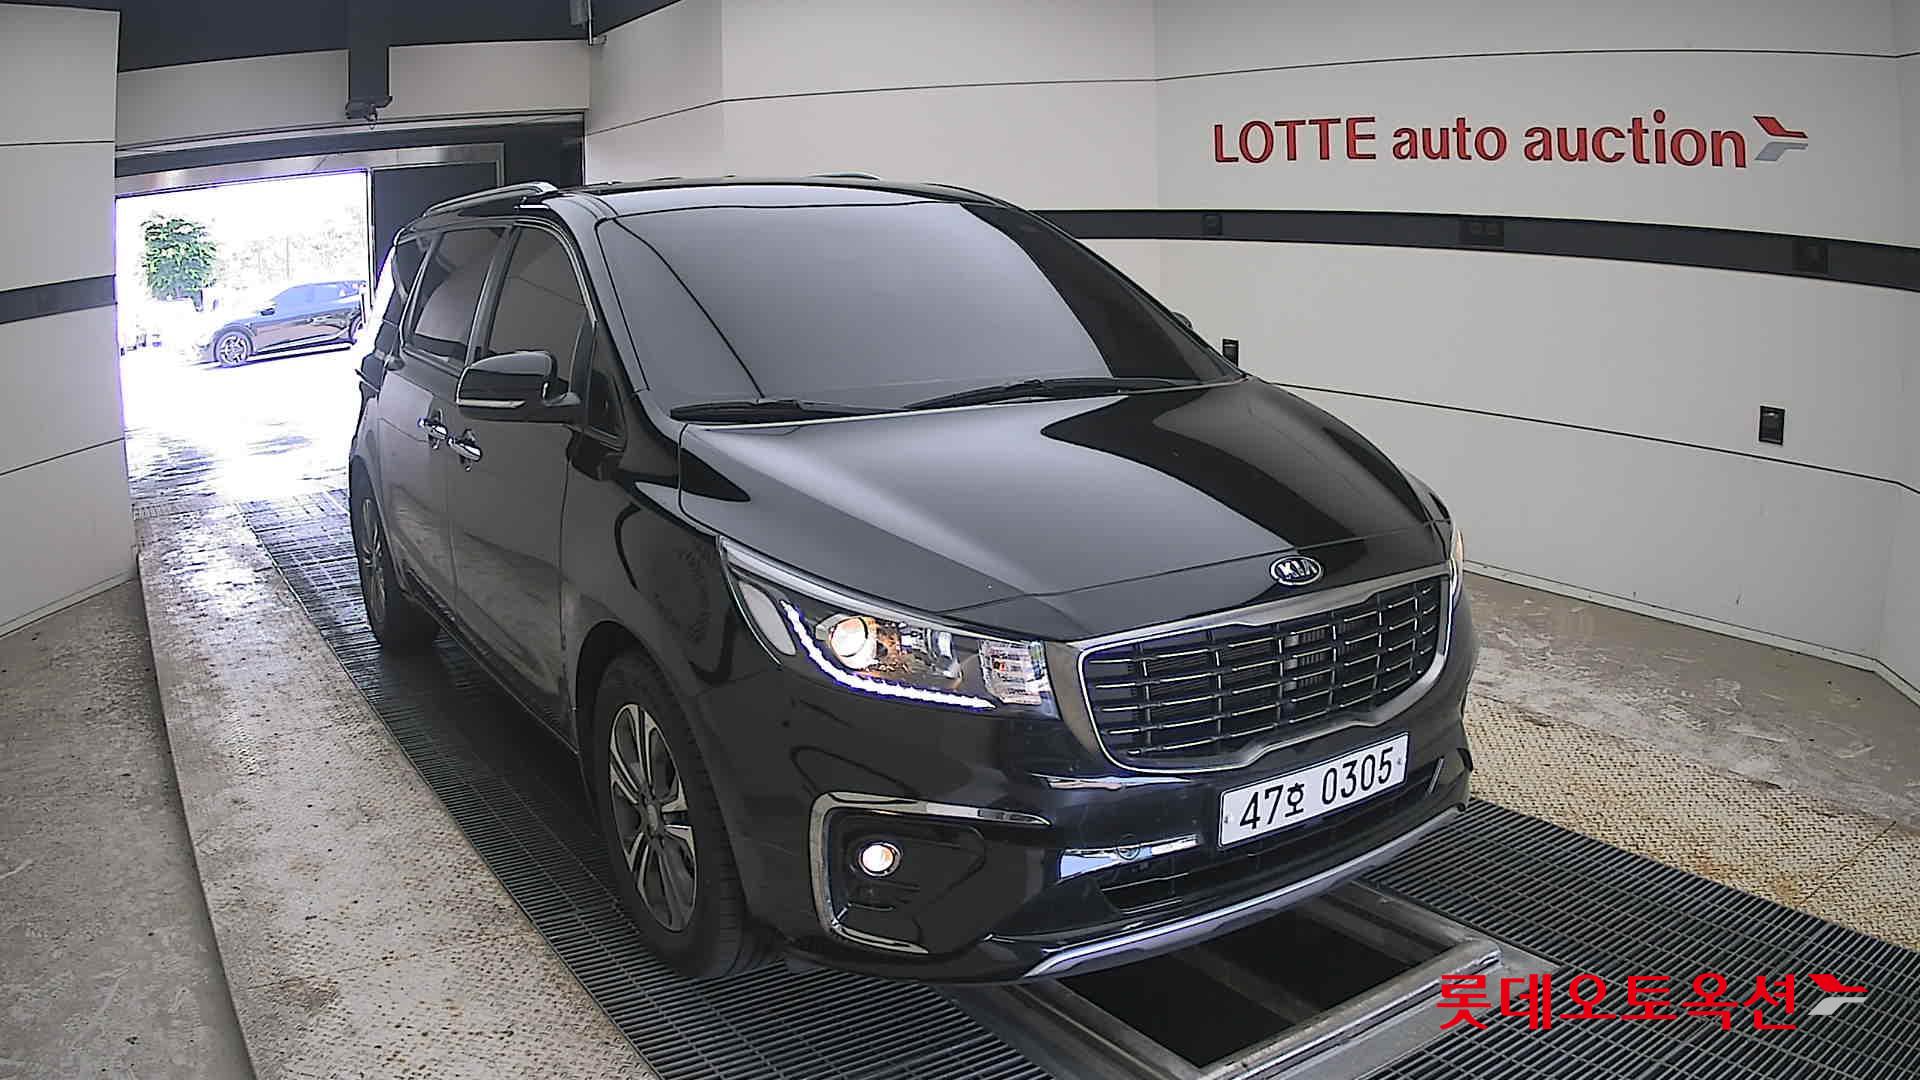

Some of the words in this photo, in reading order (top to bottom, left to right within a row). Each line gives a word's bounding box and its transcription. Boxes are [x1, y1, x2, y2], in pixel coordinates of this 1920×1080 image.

[1212, 115, 1378, 164] LOTTE
[1391, 117, 1510, 162] auto
[1523, 109, 1749, 169] auction
[1275, 558, 1319, 581] KIA
[1239, 782, 1305, 830] 47호
[1321, 747, 1394, 805] 0305
